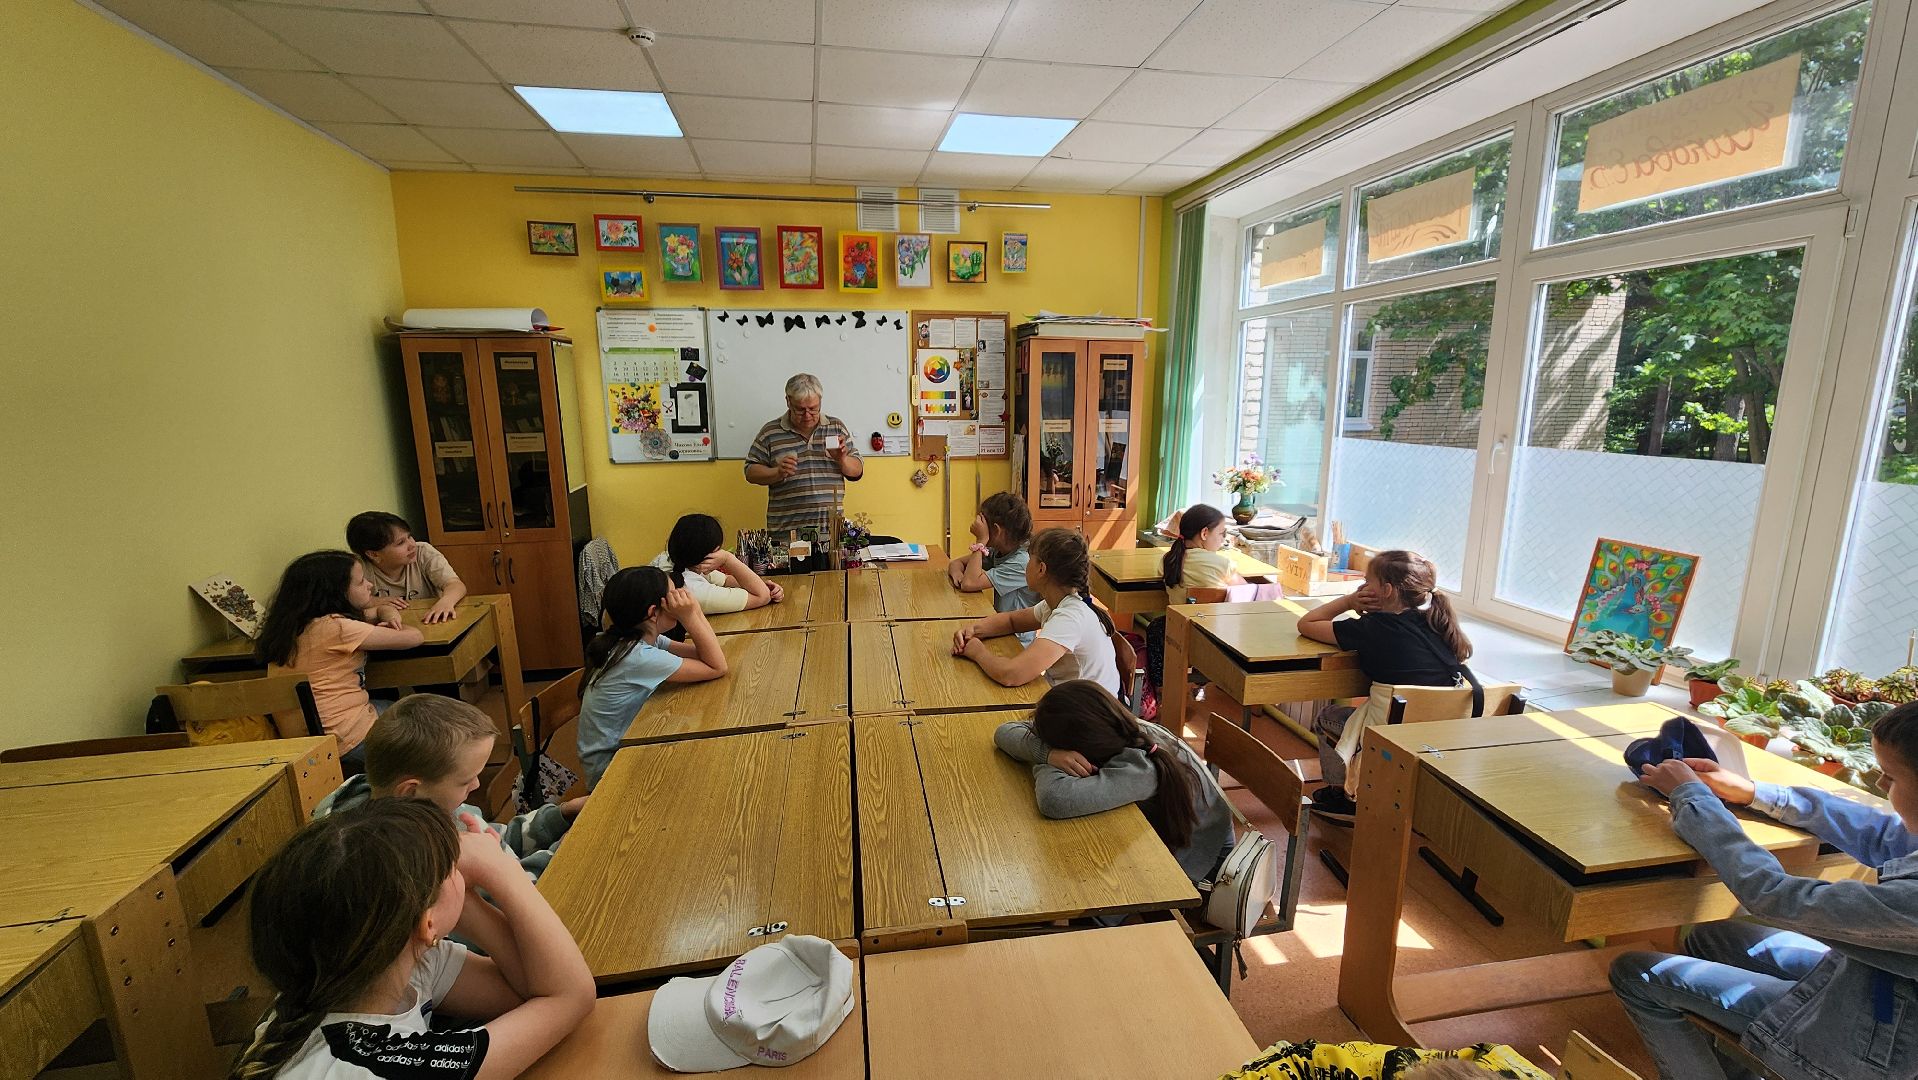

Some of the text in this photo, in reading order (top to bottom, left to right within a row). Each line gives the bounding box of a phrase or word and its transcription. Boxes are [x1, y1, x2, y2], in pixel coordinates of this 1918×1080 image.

[434, 1042, 465, 1054] adidas
[757, 1046, 788, 1061] PARIS
[376, 1053, 461, 1070] adidas adidas
